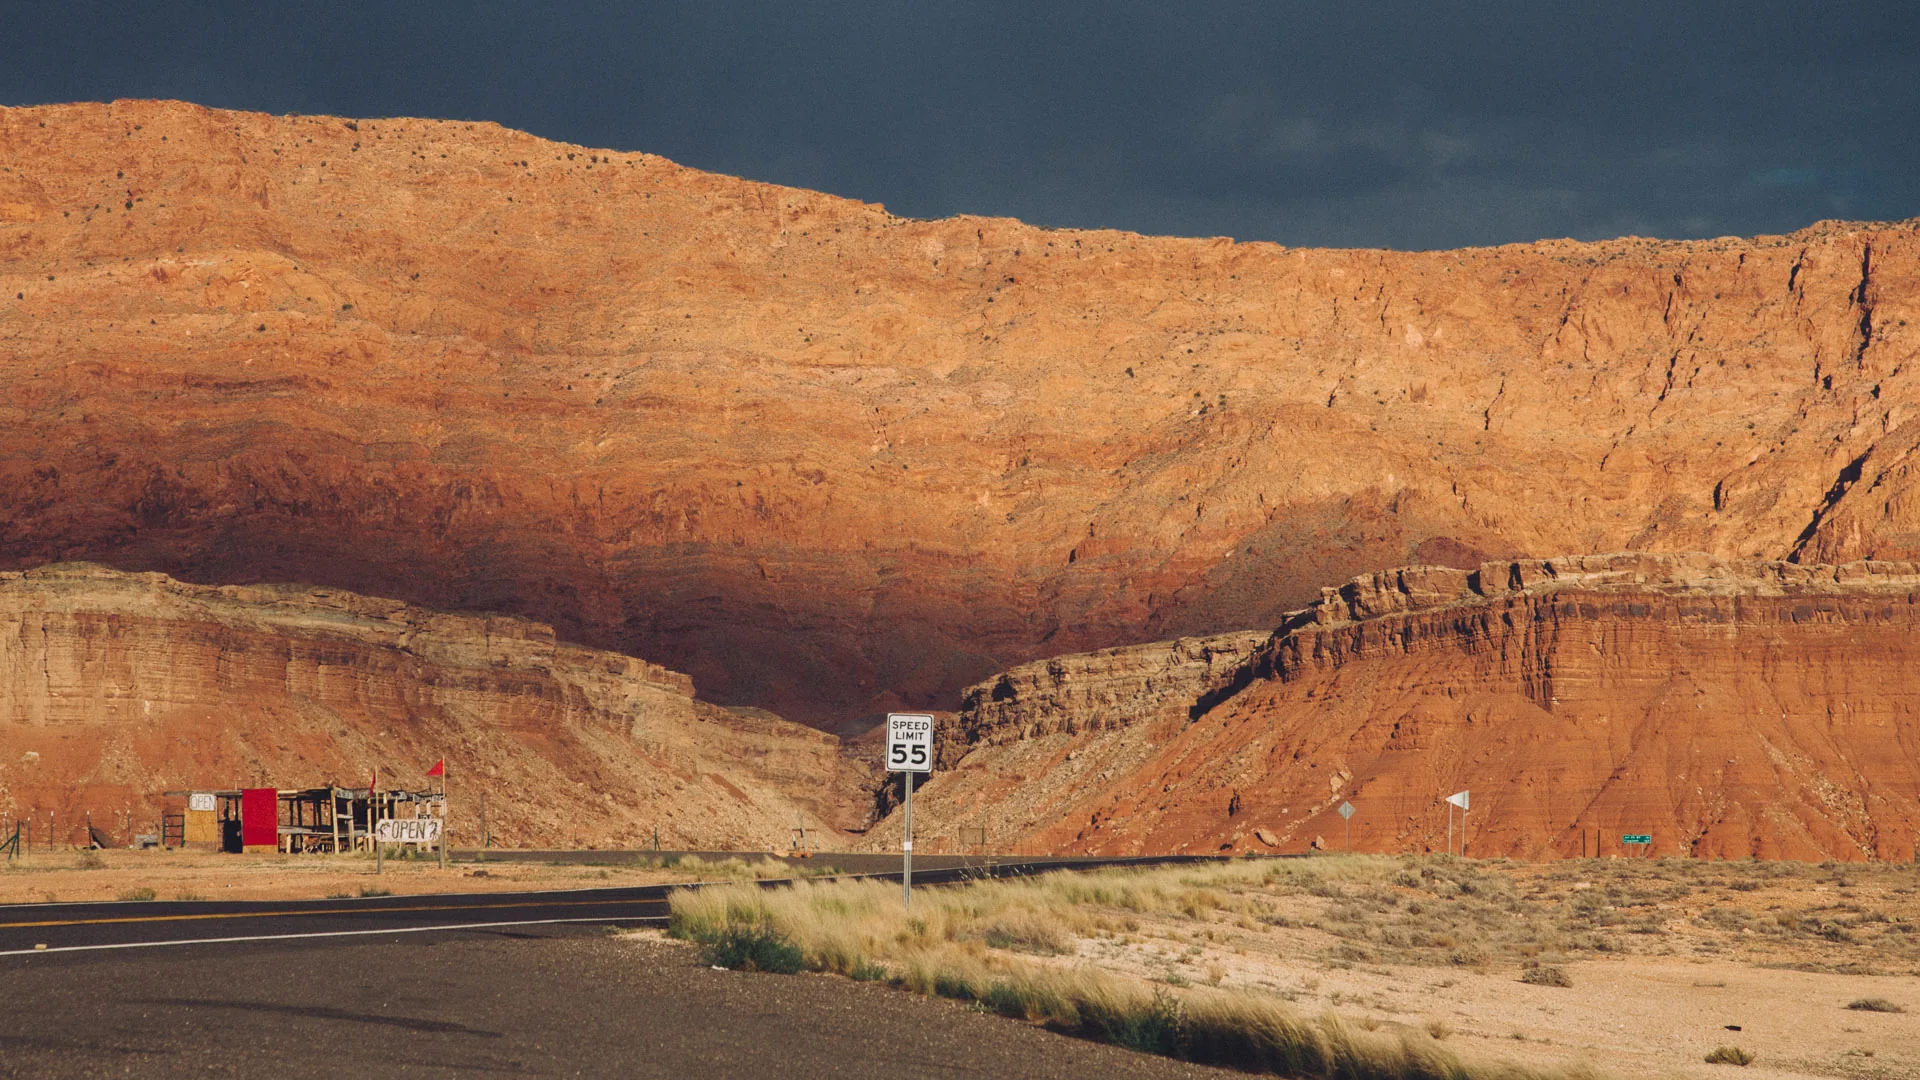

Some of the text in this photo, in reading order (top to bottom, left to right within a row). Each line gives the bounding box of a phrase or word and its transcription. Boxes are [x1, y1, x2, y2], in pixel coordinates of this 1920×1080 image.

[892, 721, 929, 730] SPEED
[895, 731, 924, 740] LIMIT
[892, 744, 927, 764] 55
[191, 795, 217, 809] OPEN
[391, 820, 426, 839] OPEN
